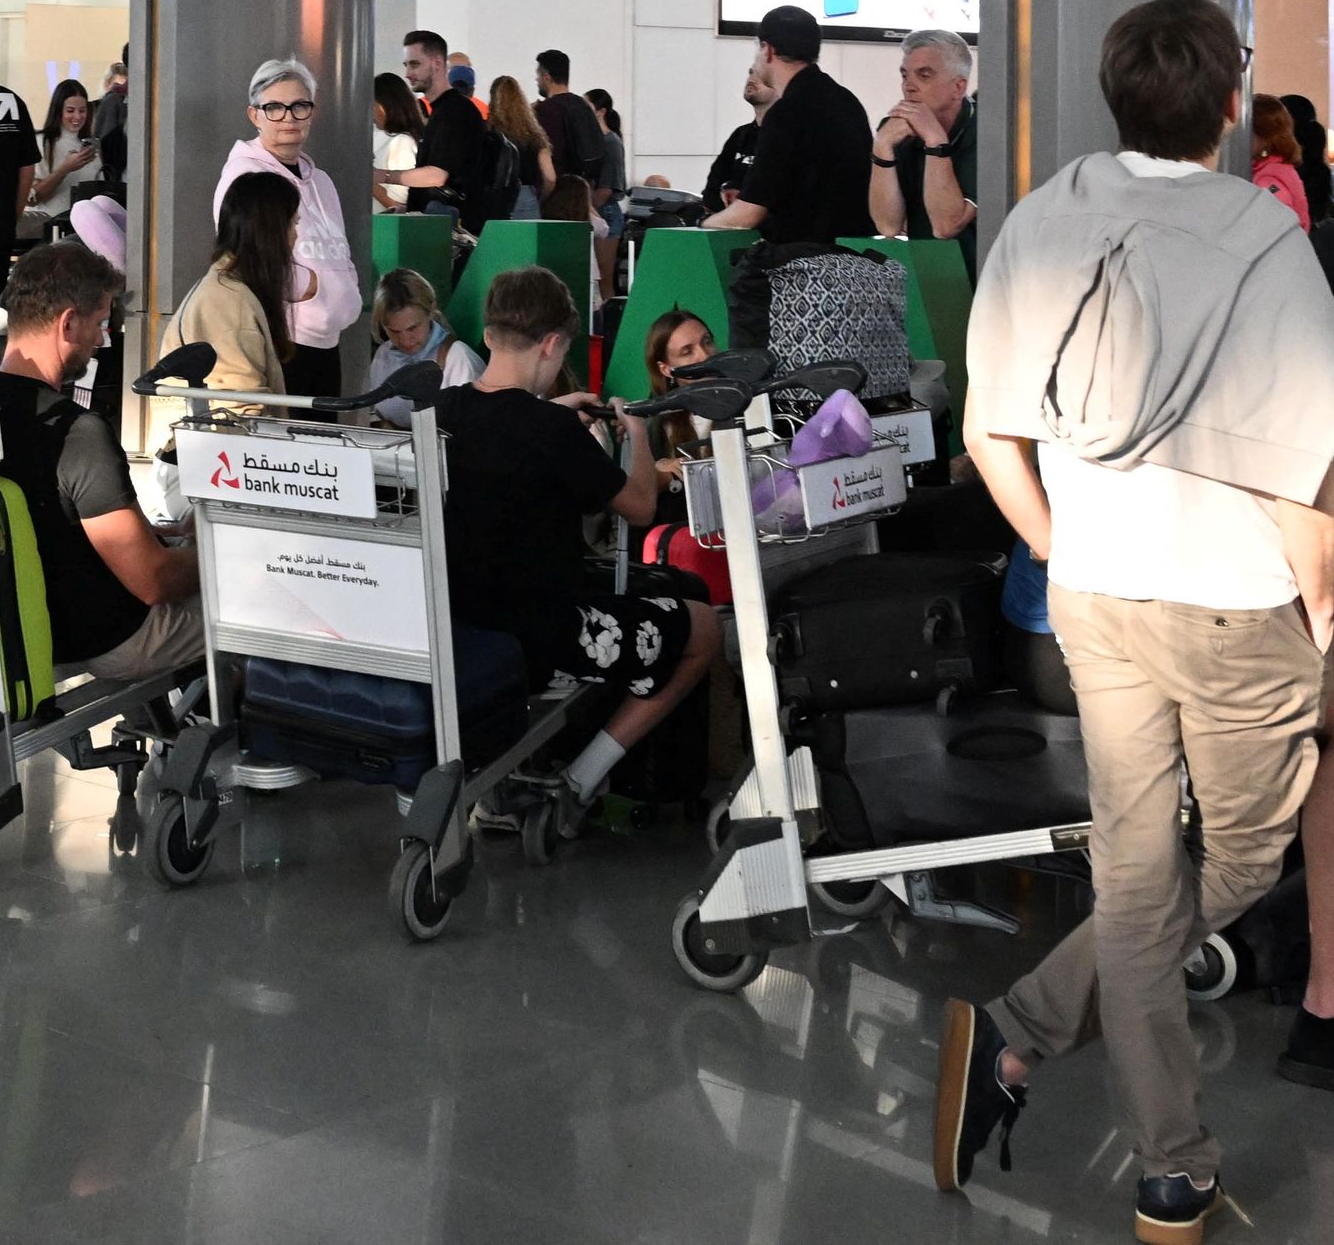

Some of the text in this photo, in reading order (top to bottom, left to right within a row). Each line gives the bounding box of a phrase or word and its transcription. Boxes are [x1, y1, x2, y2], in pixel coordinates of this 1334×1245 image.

[243, 453, 338, 483] بنك مسقط
[868, 464, 883, 483] بنك
[244, 474, 340, 500] bank muscat
[845, 485, 884, 506] bank muscat
[293, 554, 304, 563] كل
[353, 561, 366, 571] بنك
[266, 563, 380, 588] Bank Muscat. Better Everyday.
